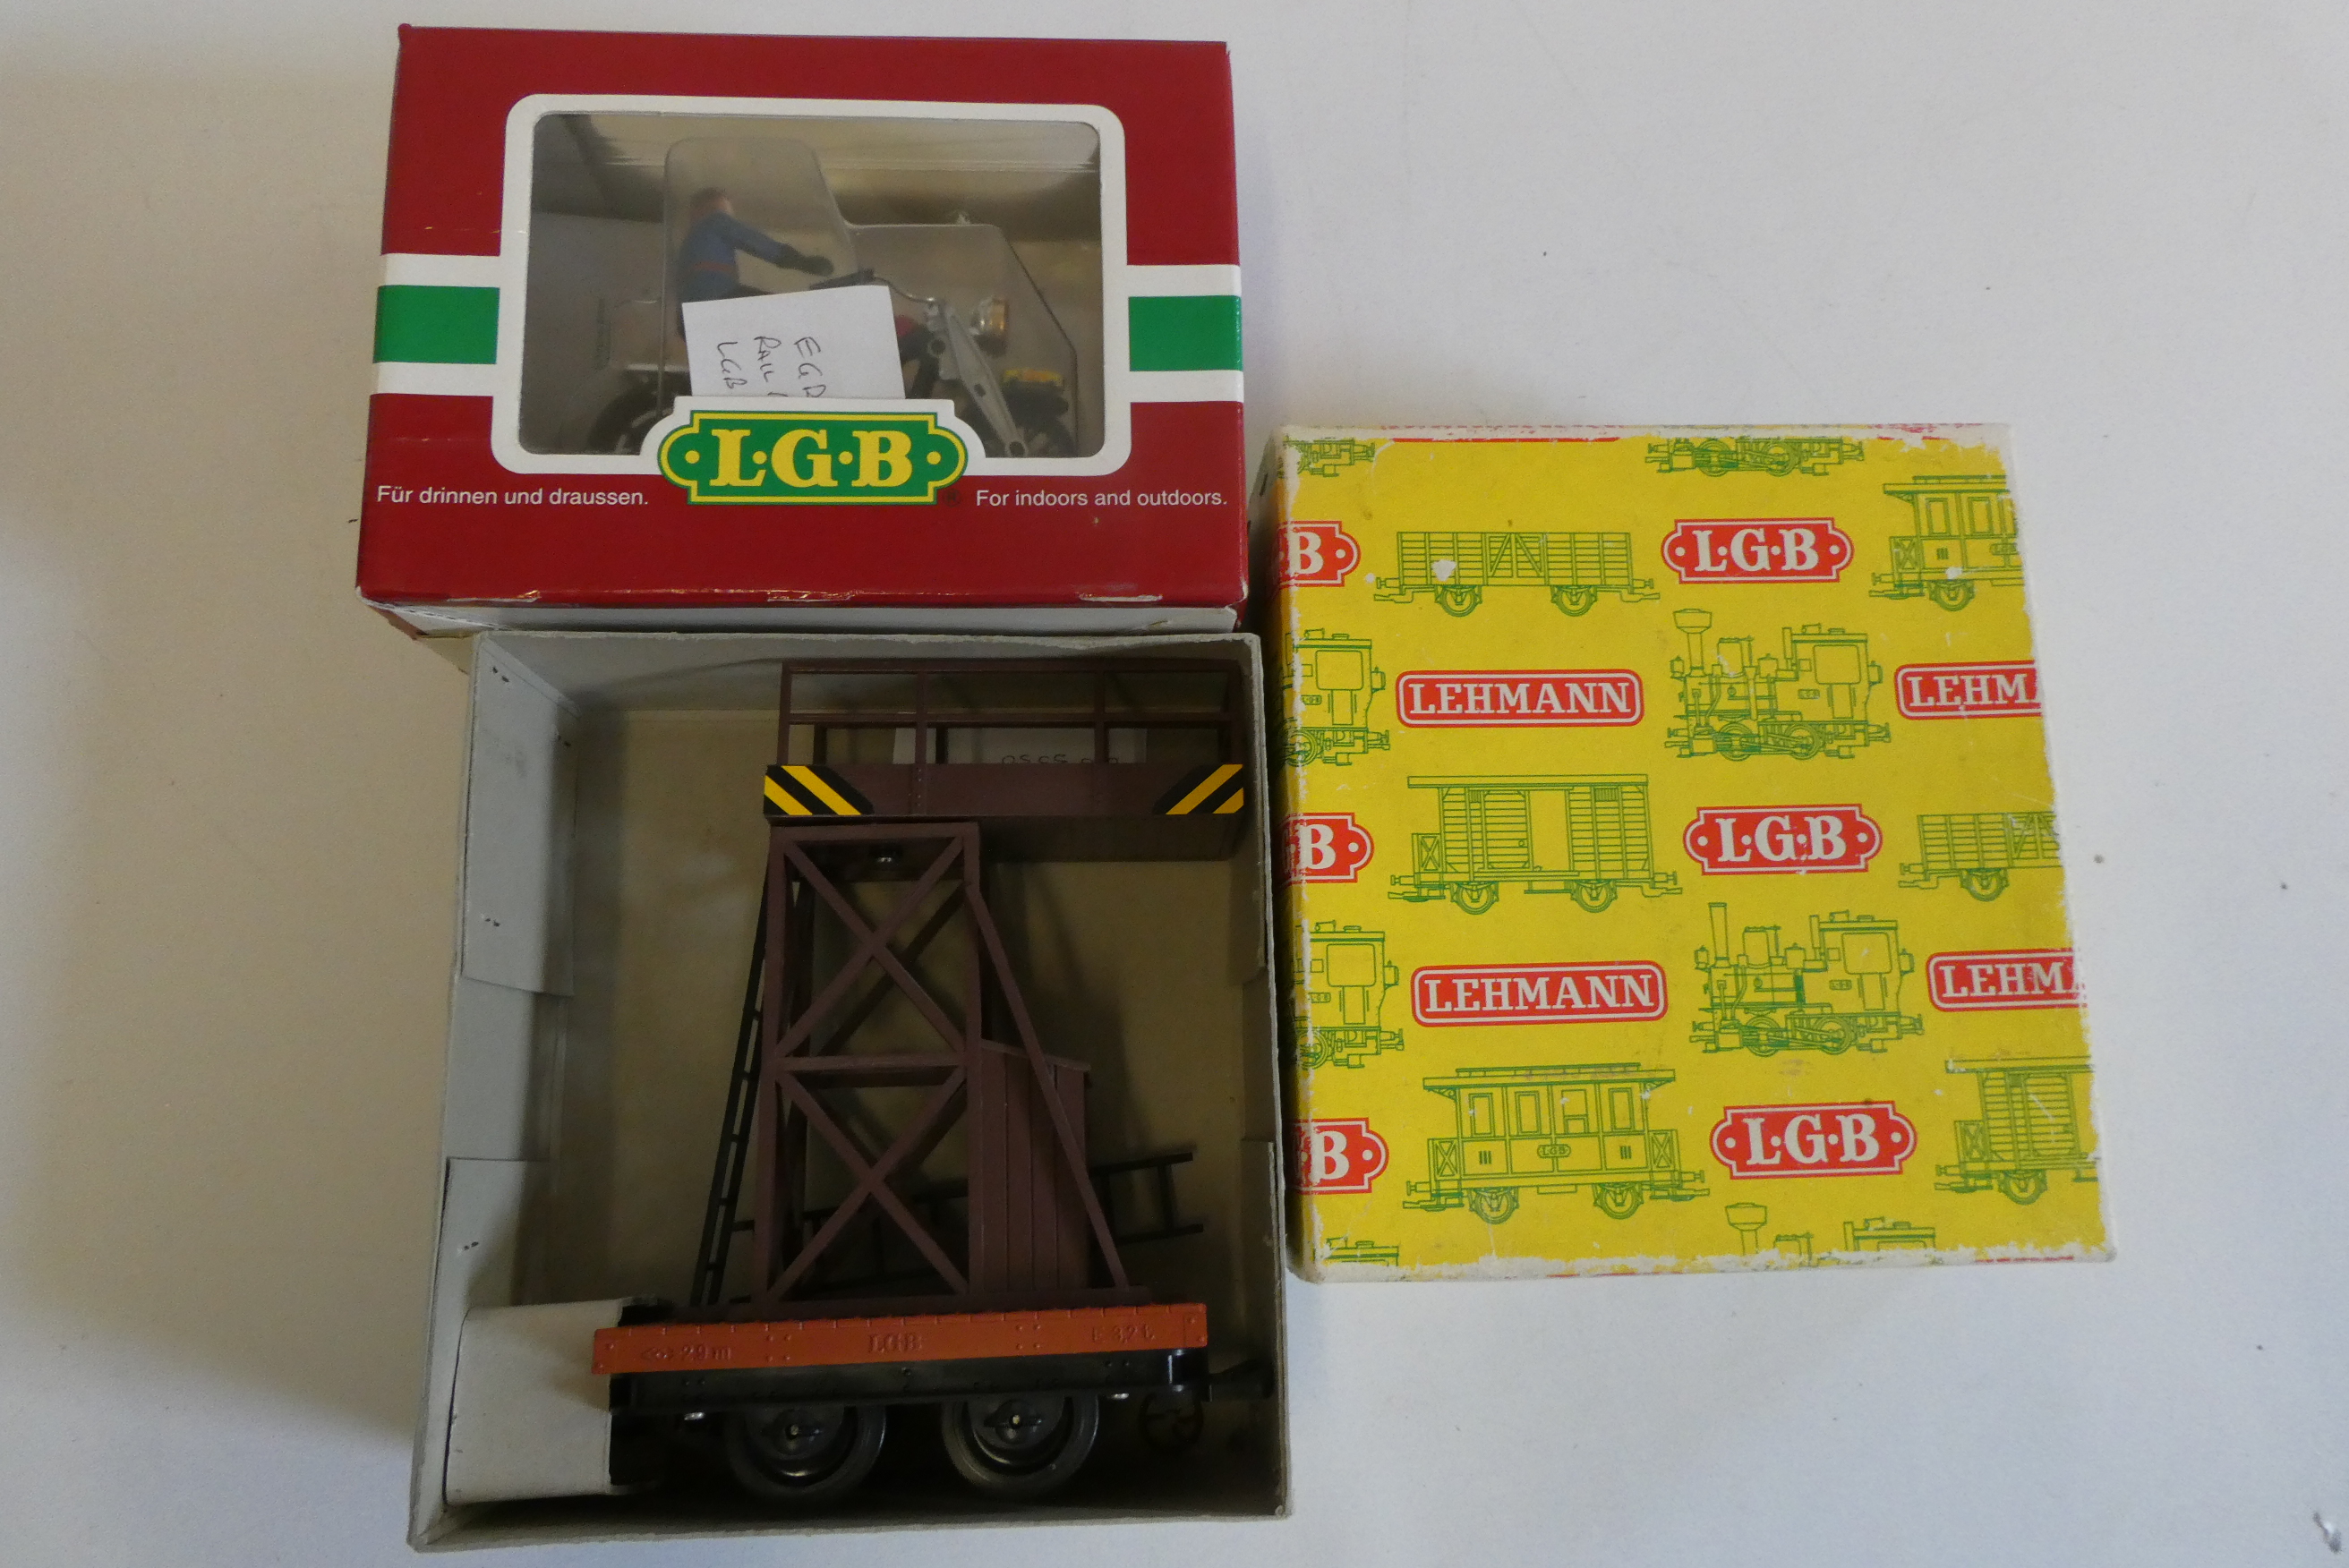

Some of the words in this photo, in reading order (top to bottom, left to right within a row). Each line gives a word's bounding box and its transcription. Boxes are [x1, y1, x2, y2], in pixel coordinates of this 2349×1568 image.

[377, 485, 414, 503] Für
[419, 487, 498, 505] drinnen
[504, 488, 543, 505] und
[549, 488, 649, 506] draussen.
[976, 490, 1008, 507] For
[1015, 490, 1089, 507] indoors
[1094, 490, 1132, 506] and
[1136, 490, 1228, 506] outdoors.
[1408, 682, 1632, 714] LEHMANN
[1906, 673, 2042, 707] LEHM
[1424, 974, 1655, 1012] LEHMANN
[1939, 961, 2080, 998] LEHM
